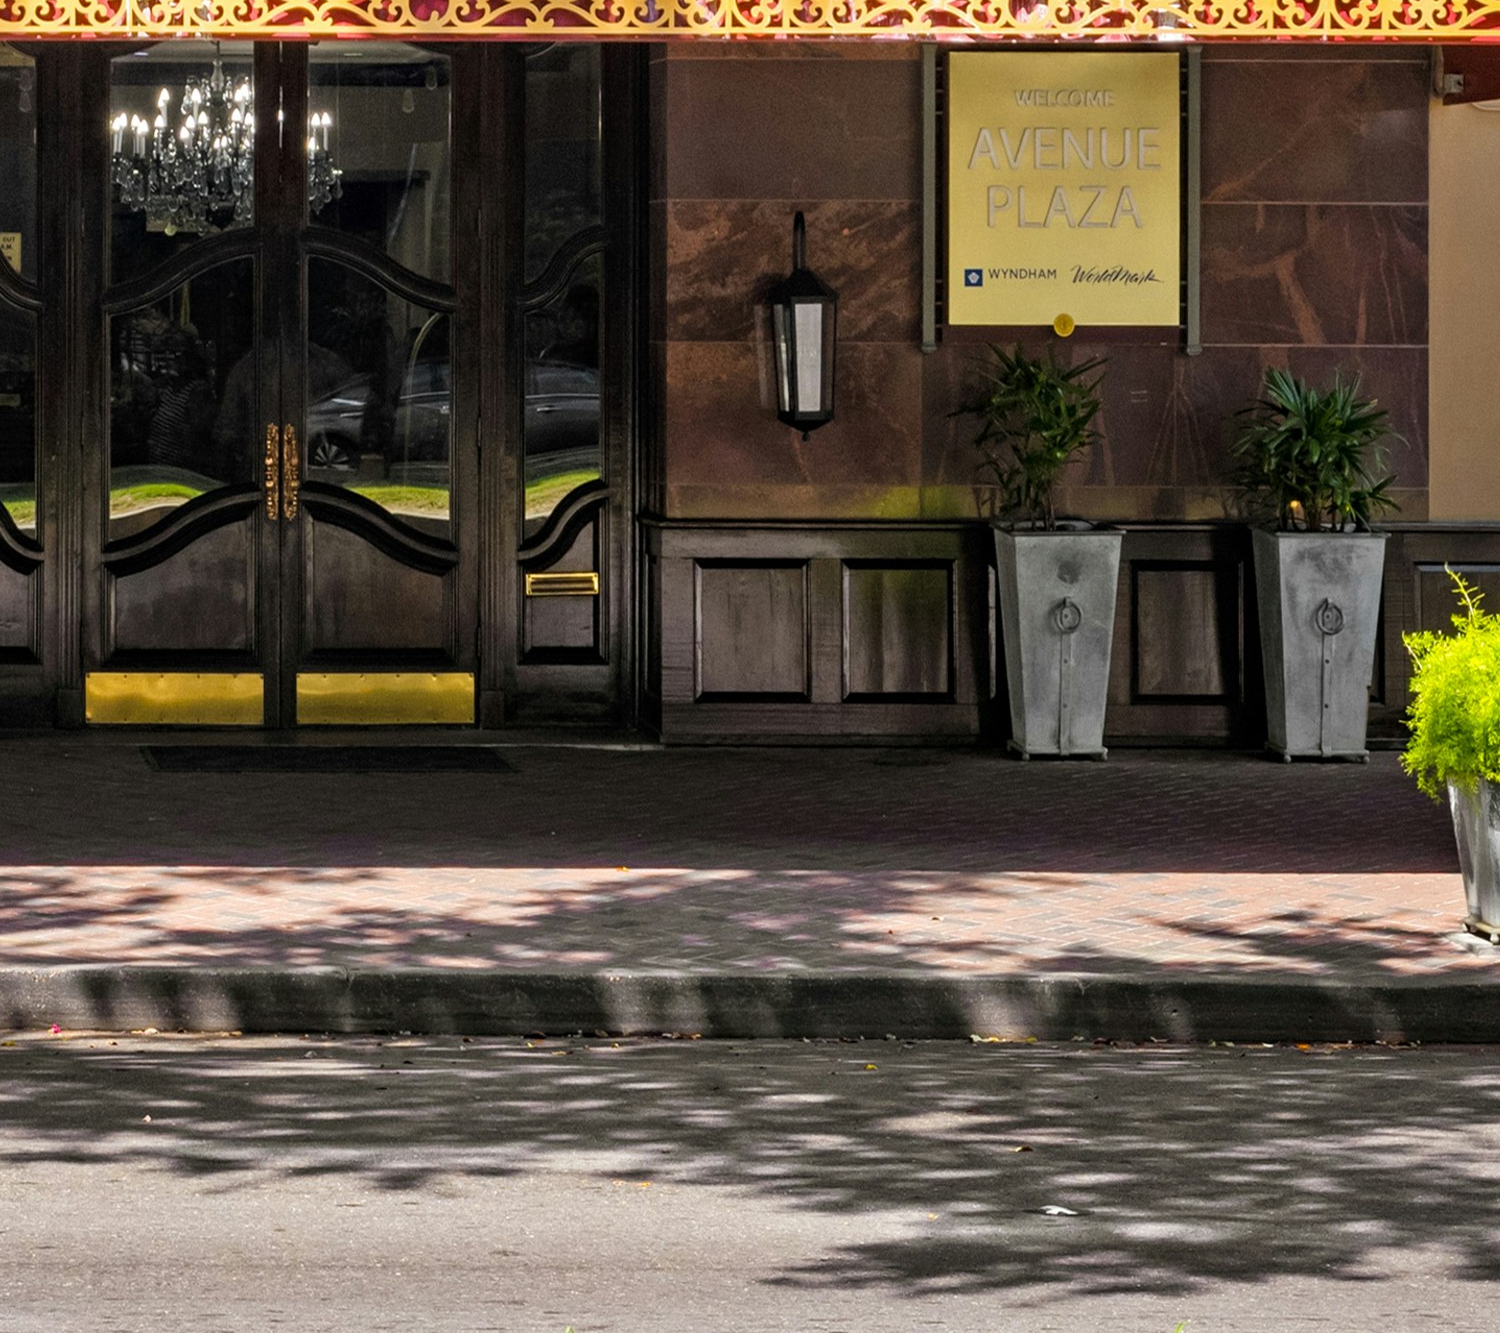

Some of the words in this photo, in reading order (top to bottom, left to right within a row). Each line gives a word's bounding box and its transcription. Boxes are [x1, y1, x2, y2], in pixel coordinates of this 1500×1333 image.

[1014, 89, 1114, 107] WELCOME
[968, 127, 1161, 170] AVENUE
[987, 185, 1142, 228] PLAZA
[988, 268, 1057, 280] WYNDHAM
[1070, 264, 1164, 286] WorldMark
